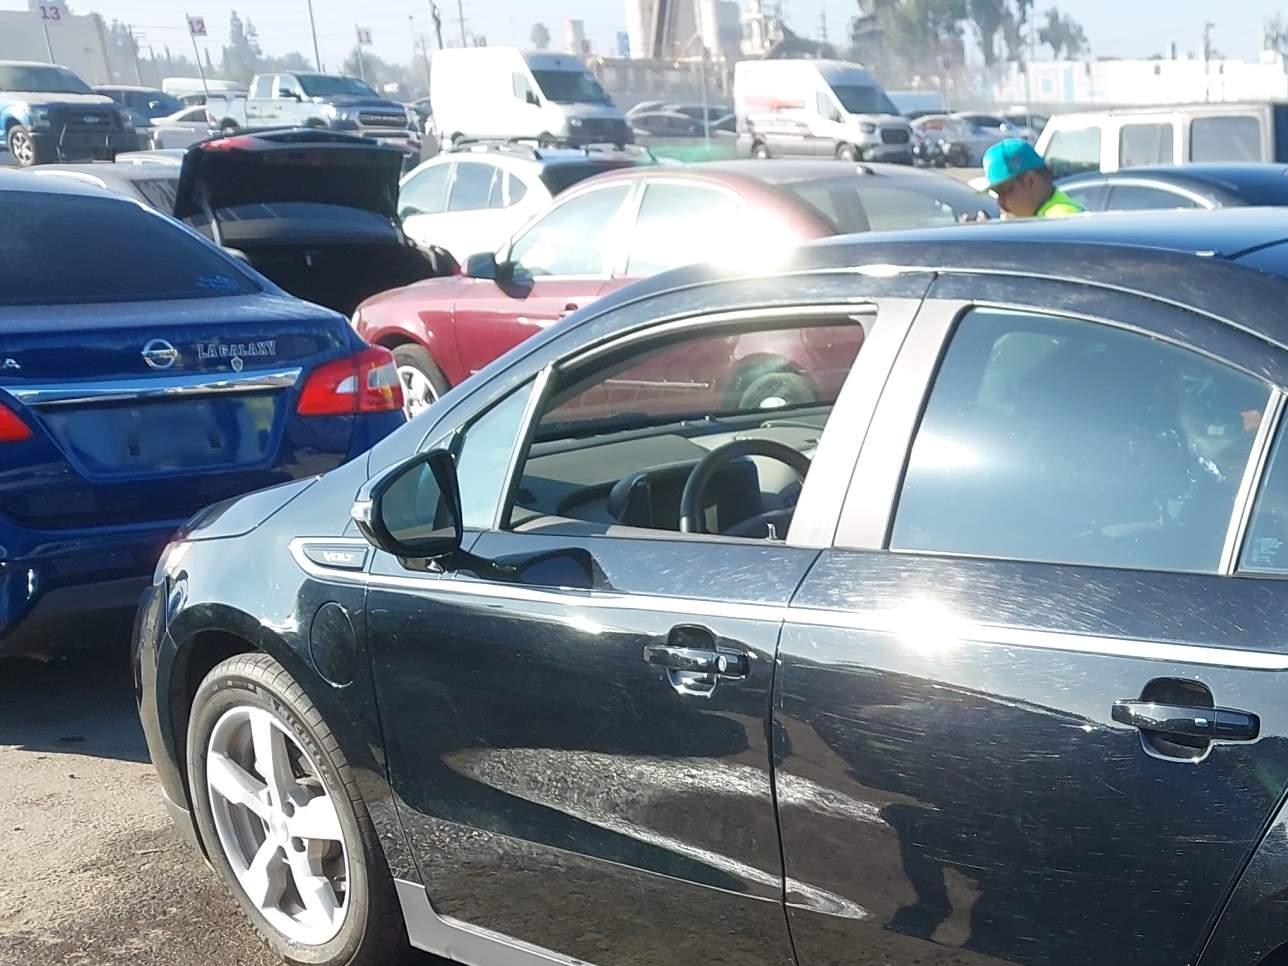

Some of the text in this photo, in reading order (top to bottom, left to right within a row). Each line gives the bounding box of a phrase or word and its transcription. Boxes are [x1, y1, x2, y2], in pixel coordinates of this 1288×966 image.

[40, 6, 61, 20] 13
[189, 20, 206, 34] 12
[218, 340, 277, 357] GALAXY
[322, 551, 354, 561] VOLT
